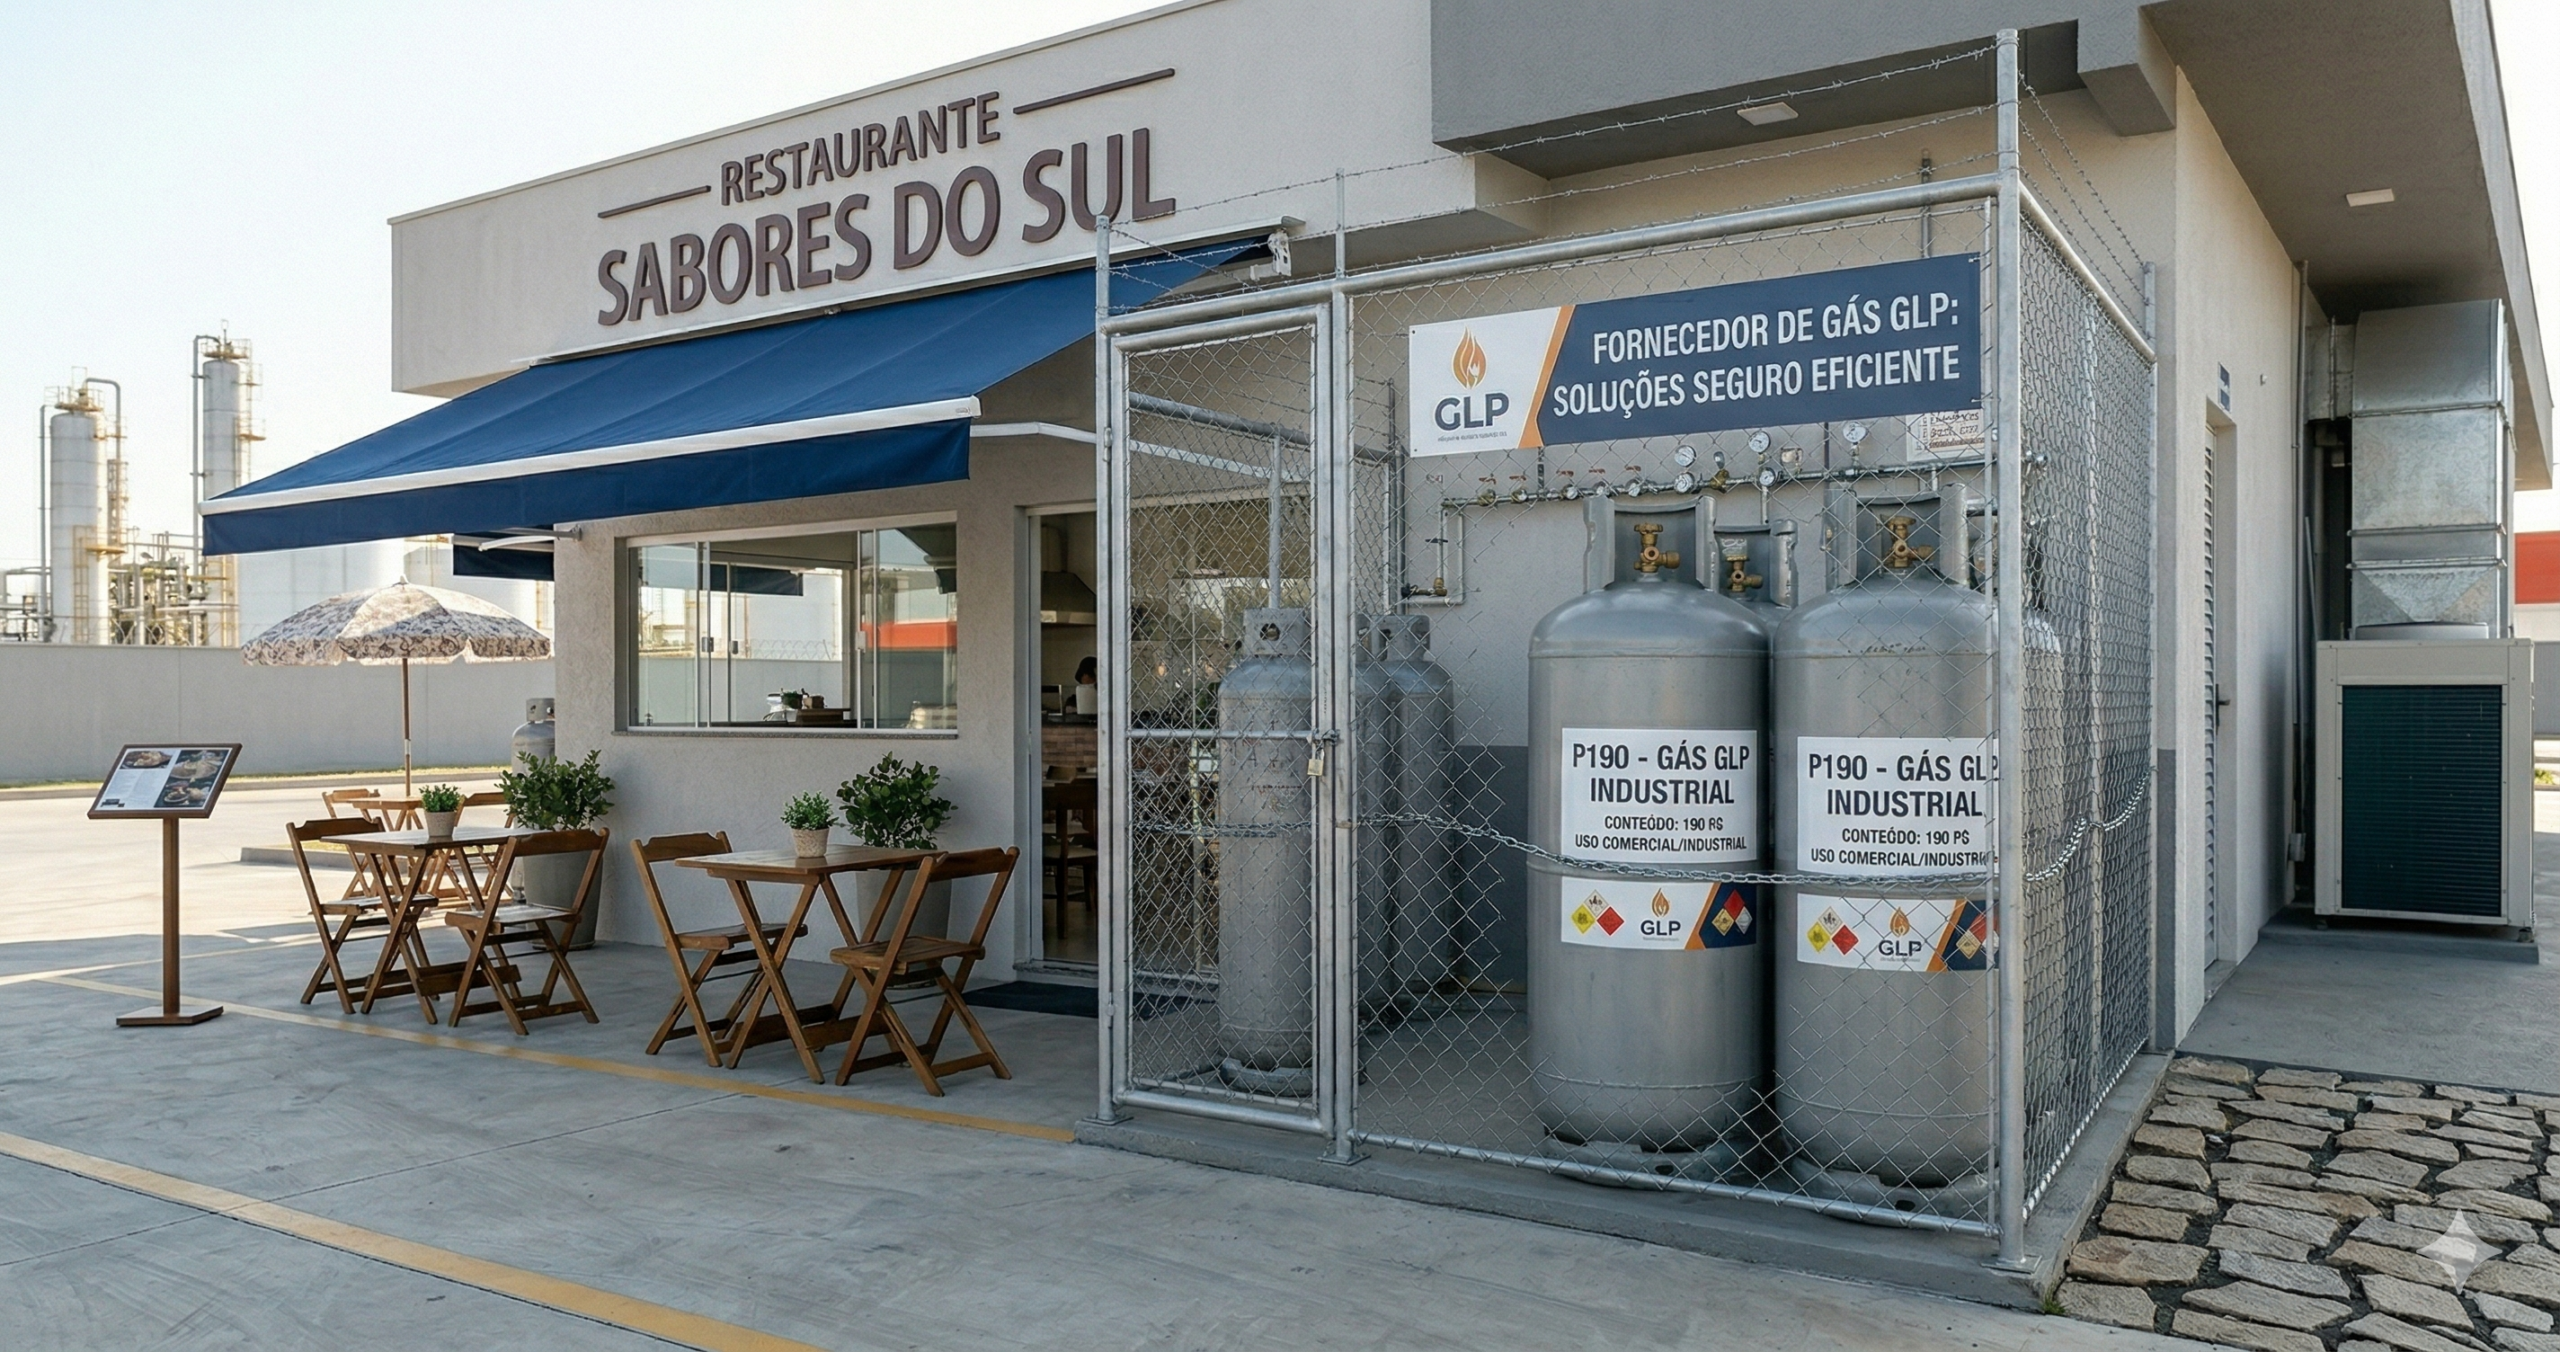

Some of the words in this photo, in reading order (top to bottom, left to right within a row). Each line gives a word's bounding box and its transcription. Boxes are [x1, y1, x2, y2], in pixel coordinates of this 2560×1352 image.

[720, 91, 1001, 206] RESTAURANTE
[598, 193, 871, 326] SABORES
[893, 165, 1001, 271] DO
[1022, 127, 1177, 243] SUL
[1593, 313, 1770, 364] FORNECEDOR
[1778, 308, 1814, 344] DE
[1822, 294, 1882, 339] GÁS
[1890, 292, 1959, 332] GLP:
[1553, 370, 1686, 419] SOLUÇÕES
[1693, 361, 1803, 404] SEGURO
[1812, 345, 1960, 392] EFICIENTE
[1434, 392, 1510, 431] GLP
[1572, 743, 1630, 769] P190
[1657, 739, 1707, 770] GÁS
[1714, 745, 1750, 770] GLP
[1808, 753, 1868, 781] P190
[1897, 749, 1951, 781] GÁS
[1590, 778, 1735, 804] INDUSTRIAL
[1827, 789, 1983, 817] INDUSTRIAL
[1684, 817, 1705, 831] 190
[1926, 831, 1949, 845] 190
[1575, 834, 1598, 848] USO
[1602, 836, 1747, 851] COMERCIAL/INDUSTRIAL
[1811, 848, 1834, 863] USO
[1640, 920, 1681, 936] GLP
[1878, 940, 1922, 957] GLP
